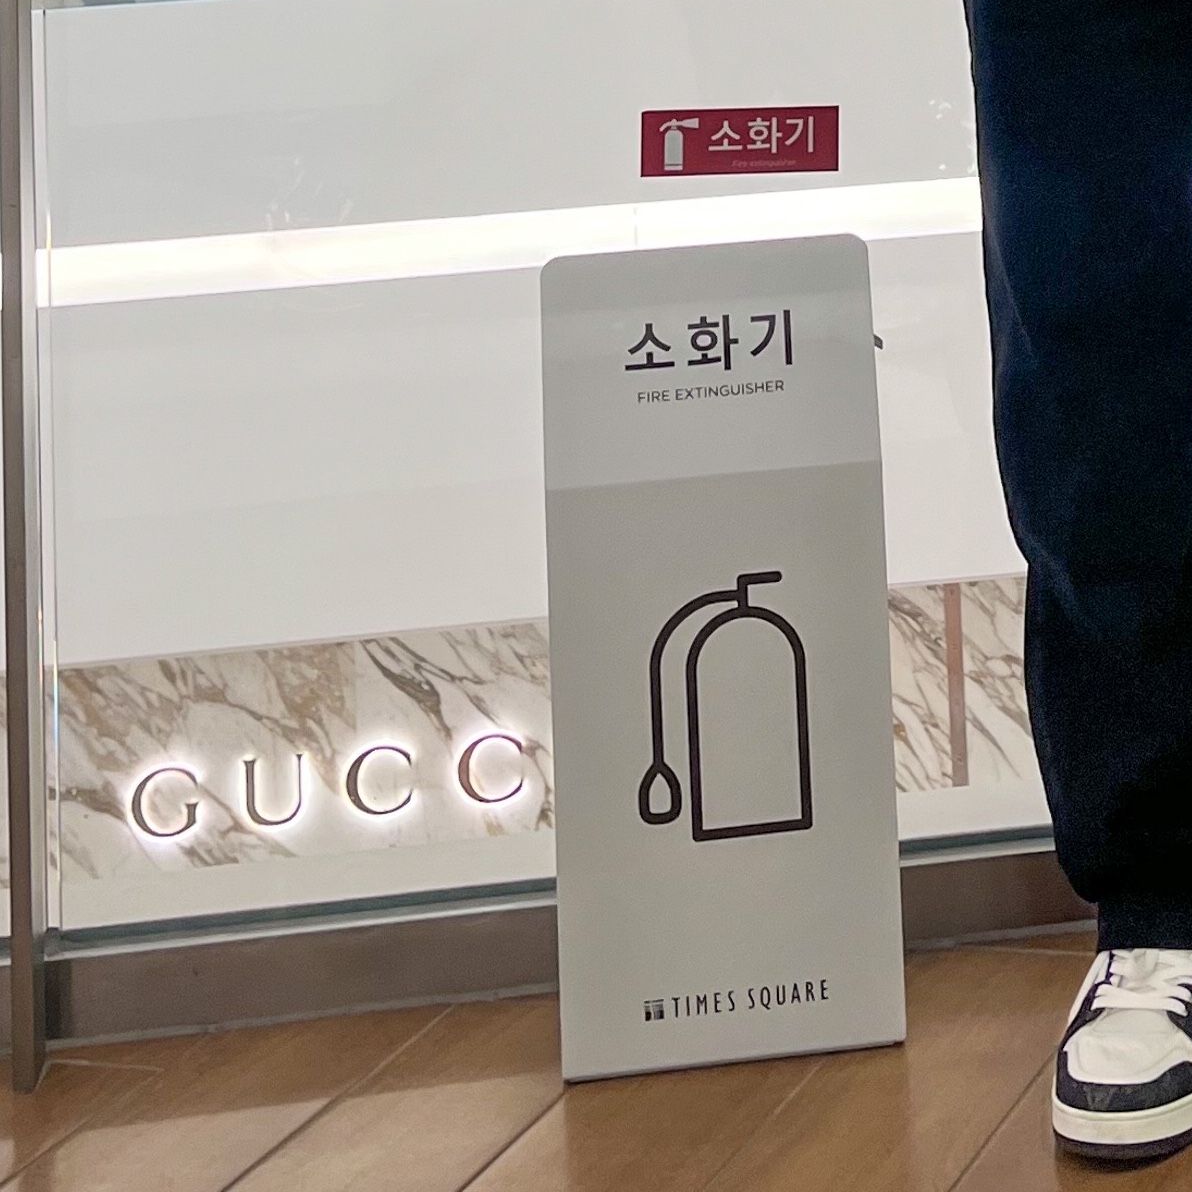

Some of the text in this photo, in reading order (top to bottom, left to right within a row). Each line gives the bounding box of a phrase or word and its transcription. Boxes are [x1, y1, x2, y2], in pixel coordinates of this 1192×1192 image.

[708, 115, 815, 154] 소화기
[624, 309, 793, 371] 소화기
[637, 379, 785, 404] FIRE EXTINGUISHER
[131, 733, 525, 838] GUCC
[671, 978, 830, 1019] TIMES SQUARE
